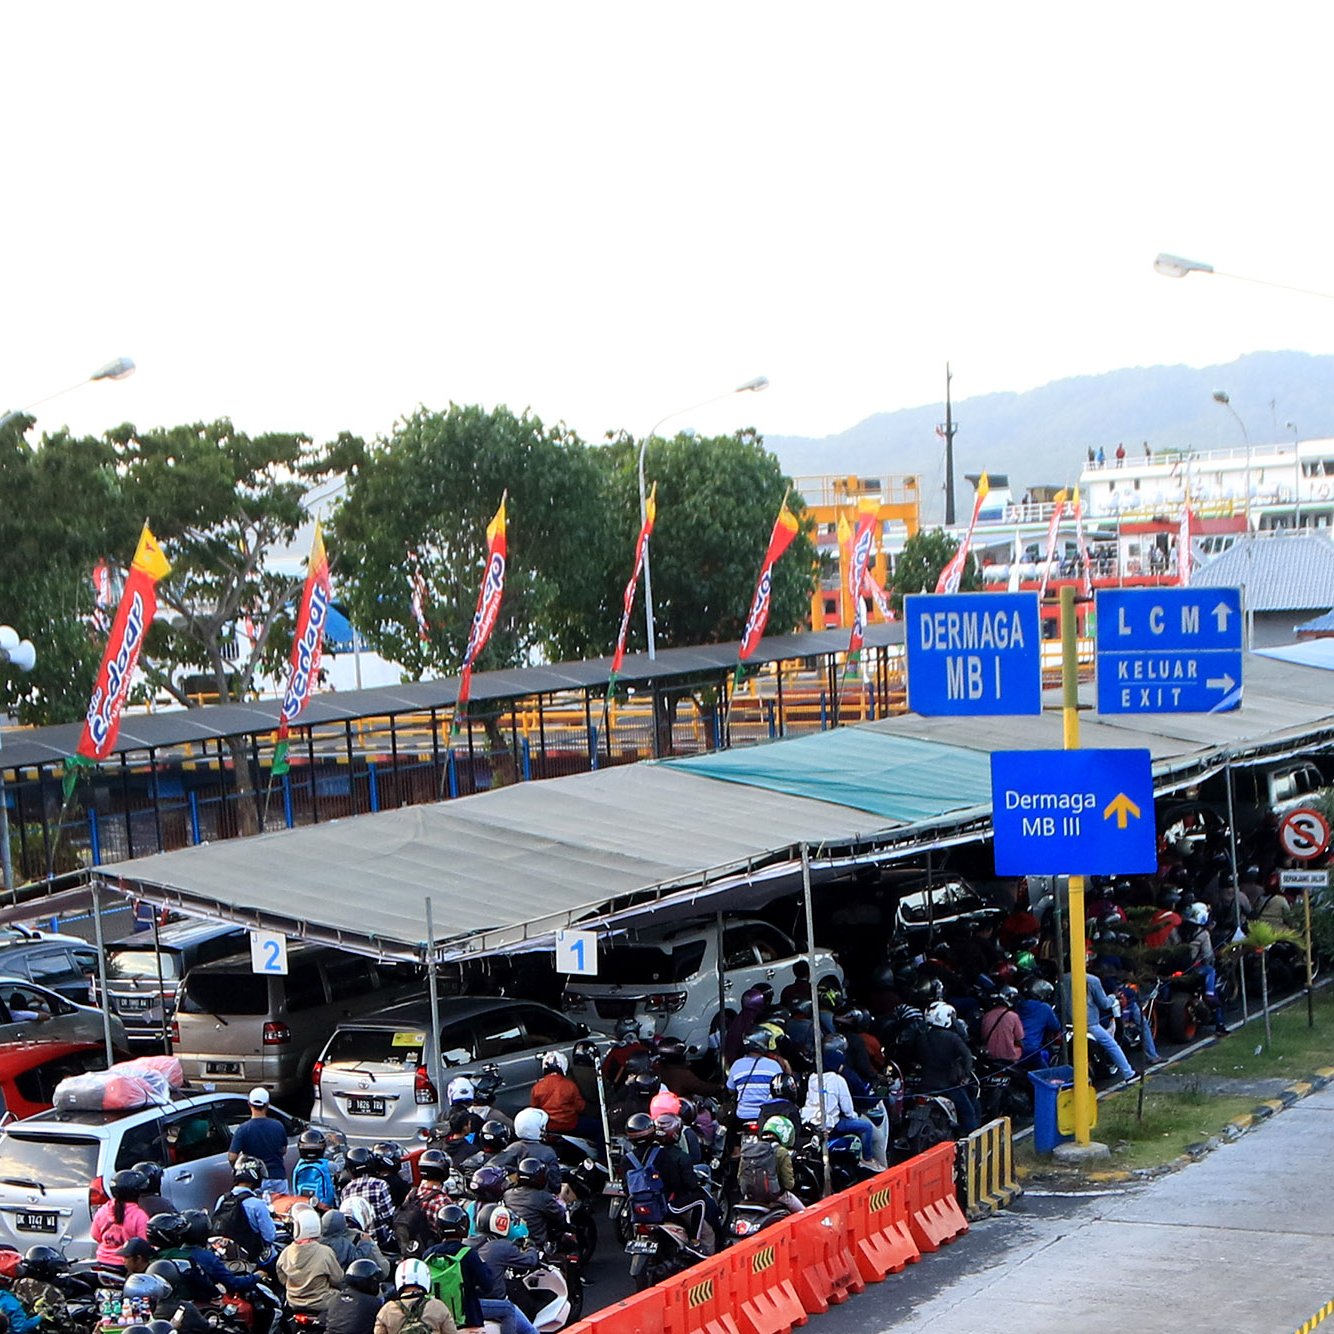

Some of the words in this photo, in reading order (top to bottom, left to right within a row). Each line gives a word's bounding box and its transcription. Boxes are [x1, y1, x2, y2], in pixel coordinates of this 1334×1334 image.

[919, 610, 1025, 651] DERMAGA
[945, 655, 984, 700] MB
[995, 655, 1002, 700] I
[1118, 659, 1198, 680] KELUAR
[1121, 687, 1182, 707] EXIT
[1005, 790, 1097, 814] Dermaga
[1022, 817, 1056, 837] MB
[1063, 817, 1081, 836] III
[263, 940, 282, 971] 2
[570, 939, 585, 971] 1
